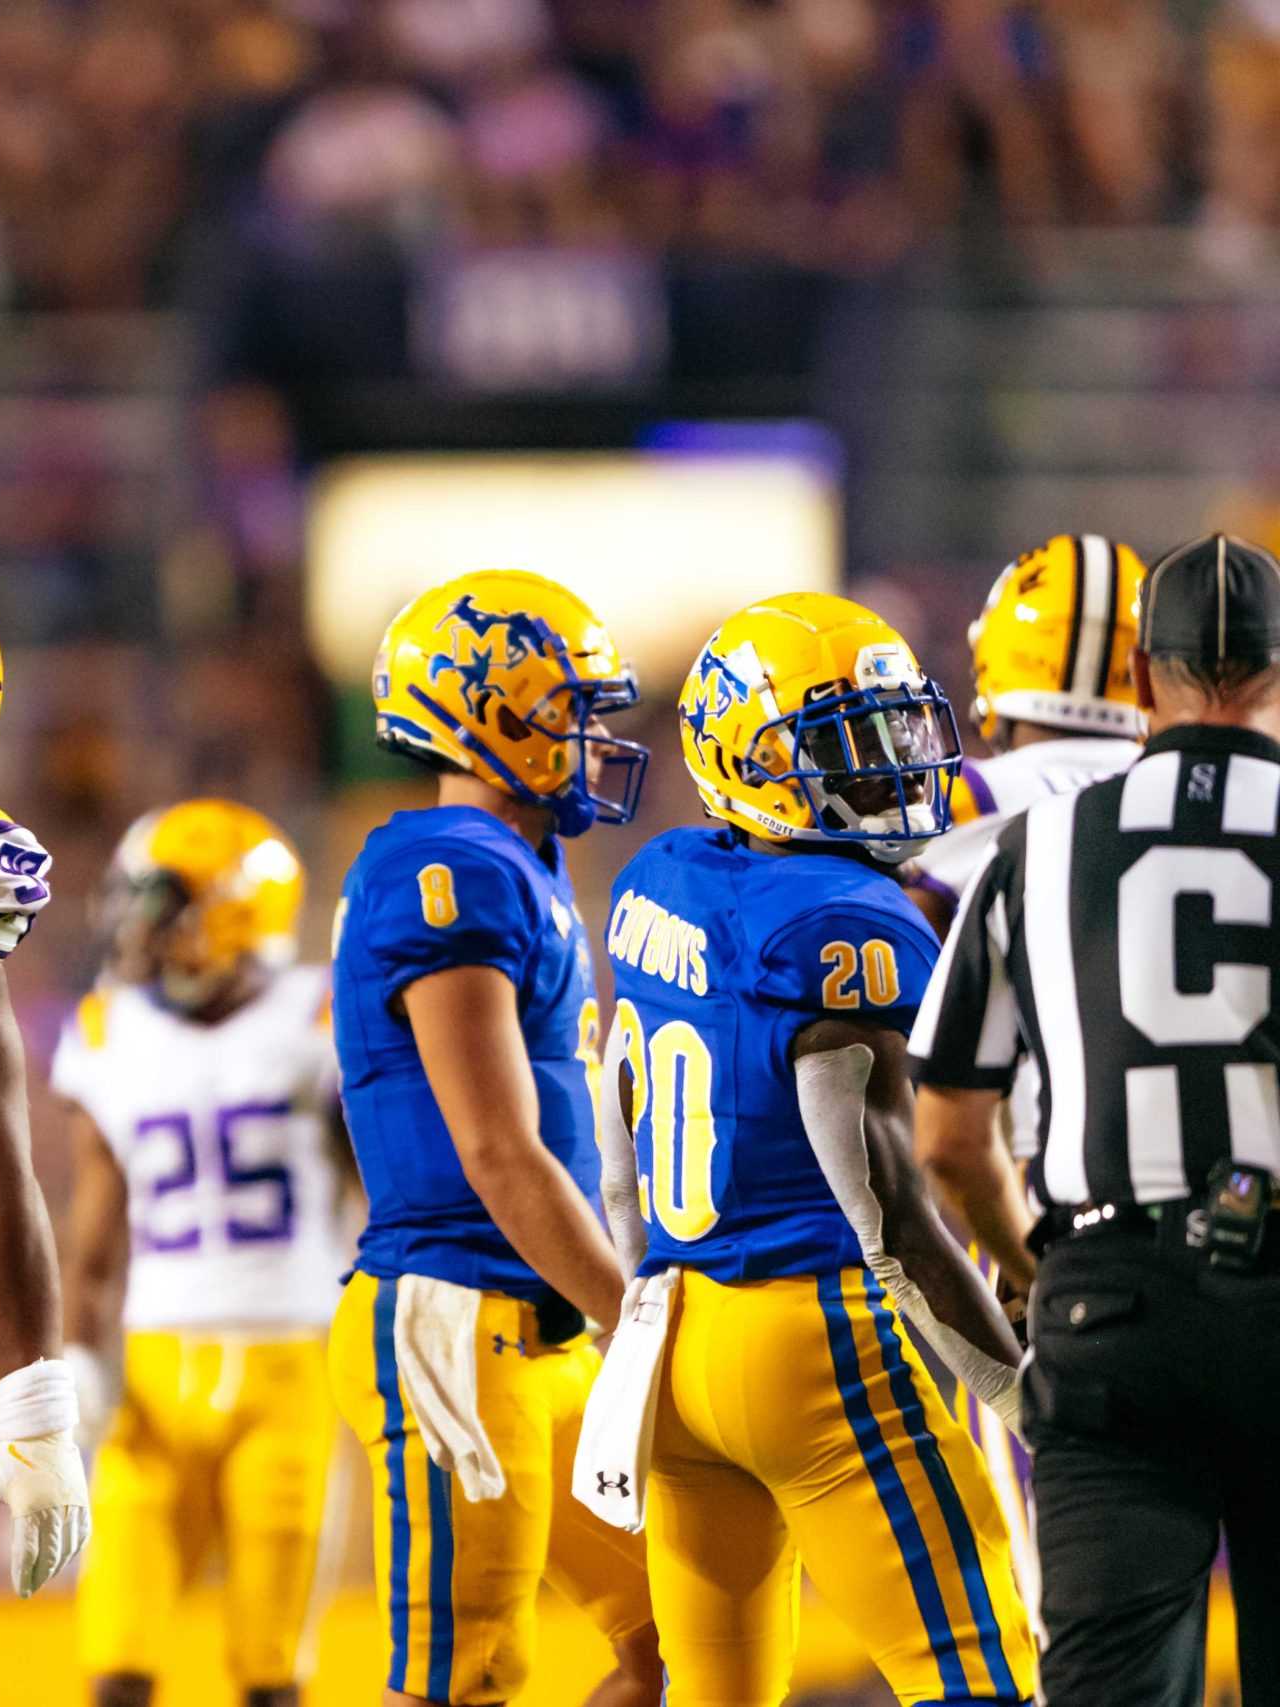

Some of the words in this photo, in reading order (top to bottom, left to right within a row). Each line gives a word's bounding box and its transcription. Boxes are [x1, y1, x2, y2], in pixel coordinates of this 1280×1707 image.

[416, 862, 460, 929] 8
[607, 888, 709, 997] COWBOYS
[1118, 845, 1272, 1046] C
[819, 937, 901, 1009] 20
[133, 1100, 297, 1253] 25
